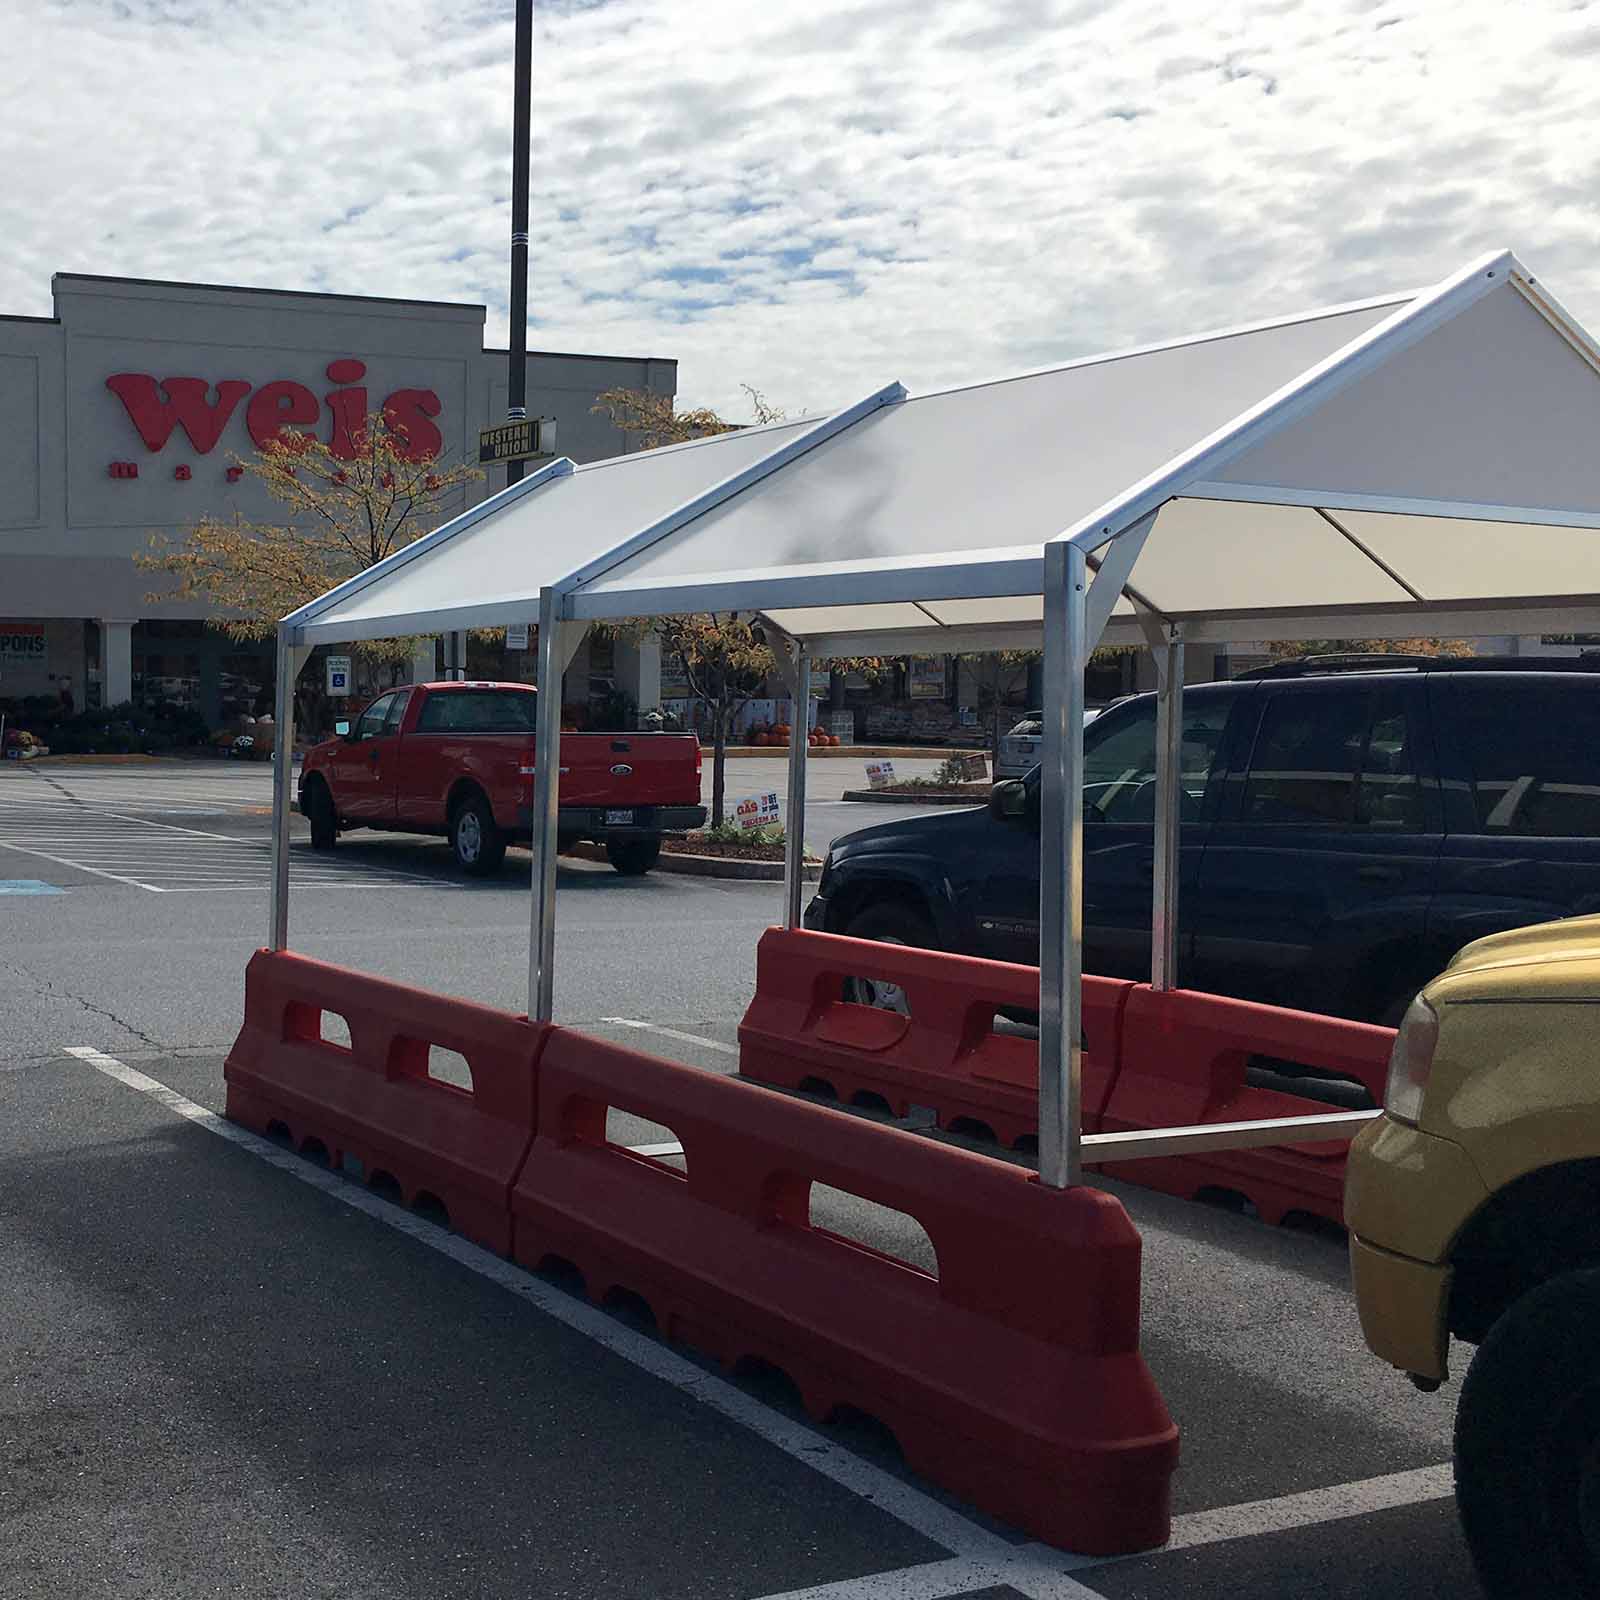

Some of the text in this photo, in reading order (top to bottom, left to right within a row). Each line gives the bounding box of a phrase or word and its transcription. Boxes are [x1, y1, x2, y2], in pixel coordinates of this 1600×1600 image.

[105, 358, 442, 464] weis
[480, 424, 529, 447] WESTERN
[495, 438, 529, 458] UNION
[737, 802, 758, 815] GAS
